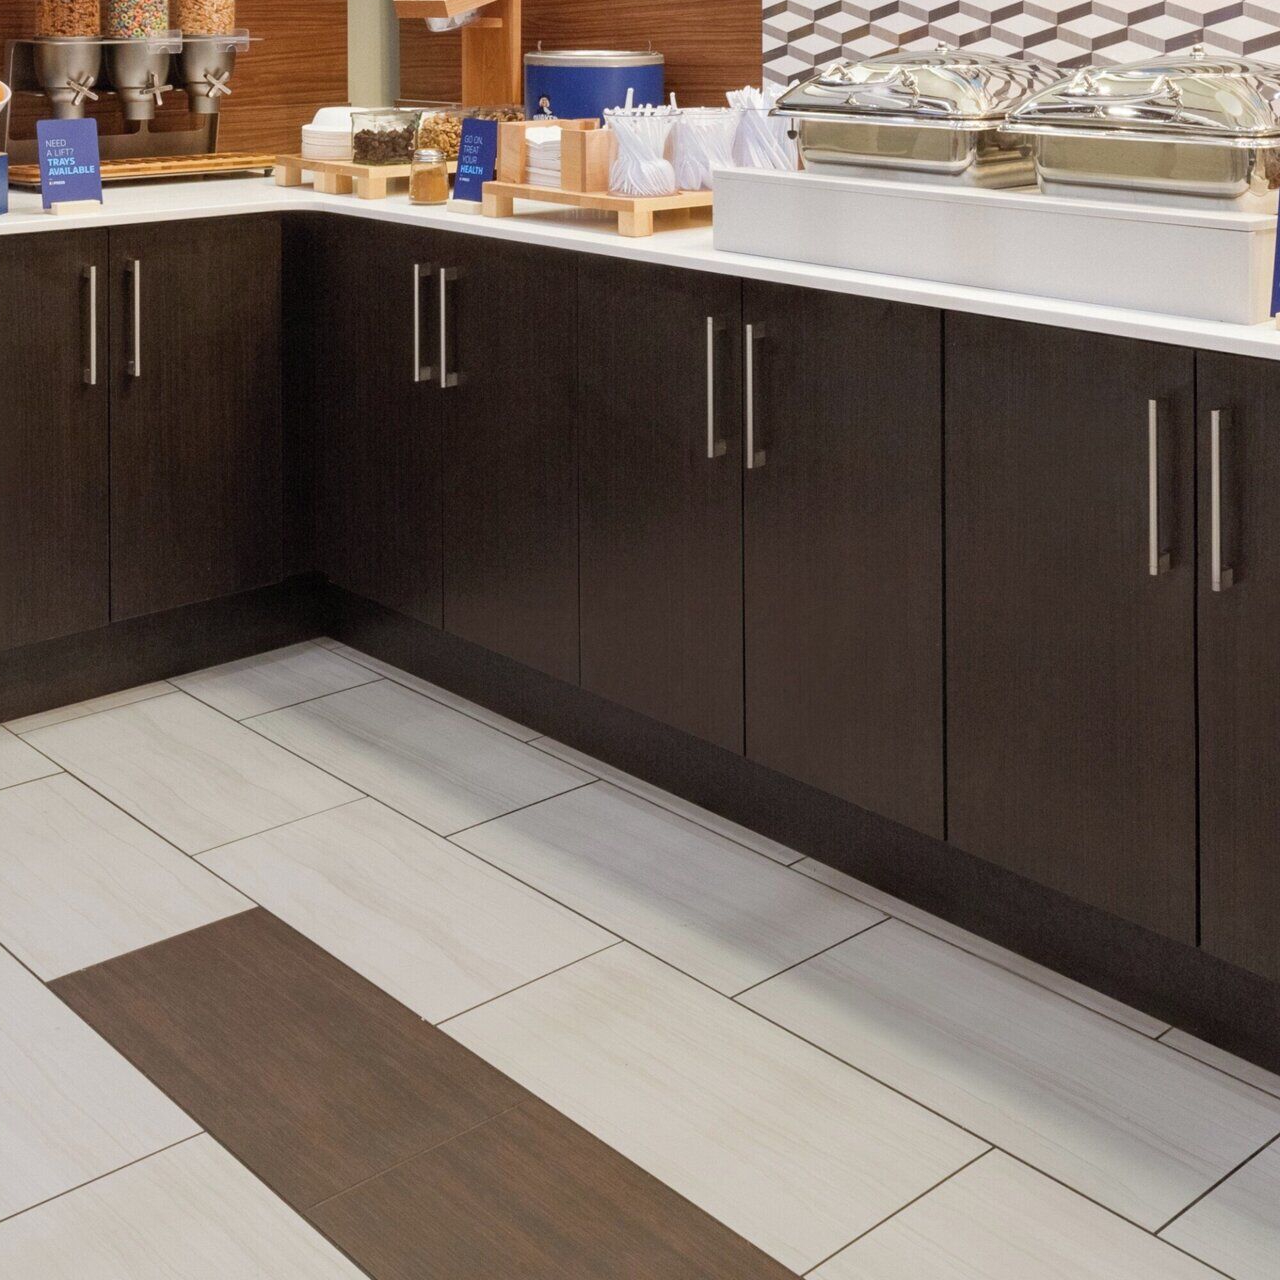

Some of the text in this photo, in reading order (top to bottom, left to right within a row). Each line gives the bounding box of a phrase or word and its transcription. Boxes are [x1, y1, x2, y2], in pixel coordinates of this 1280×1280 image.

[45, 139, 66, 148] NEED
[464, 135, 473, 144] GO
[46, 148, 74, 157] A LIFT?
[463, 145, 479, 154] TREAT
[47, 157, 76, 166] TRAYS
[462, 155, 478, 164] YOUR
[49, 165, 95, 176] AVAILABLE
[460, 165, 484, 175] HEALTH
